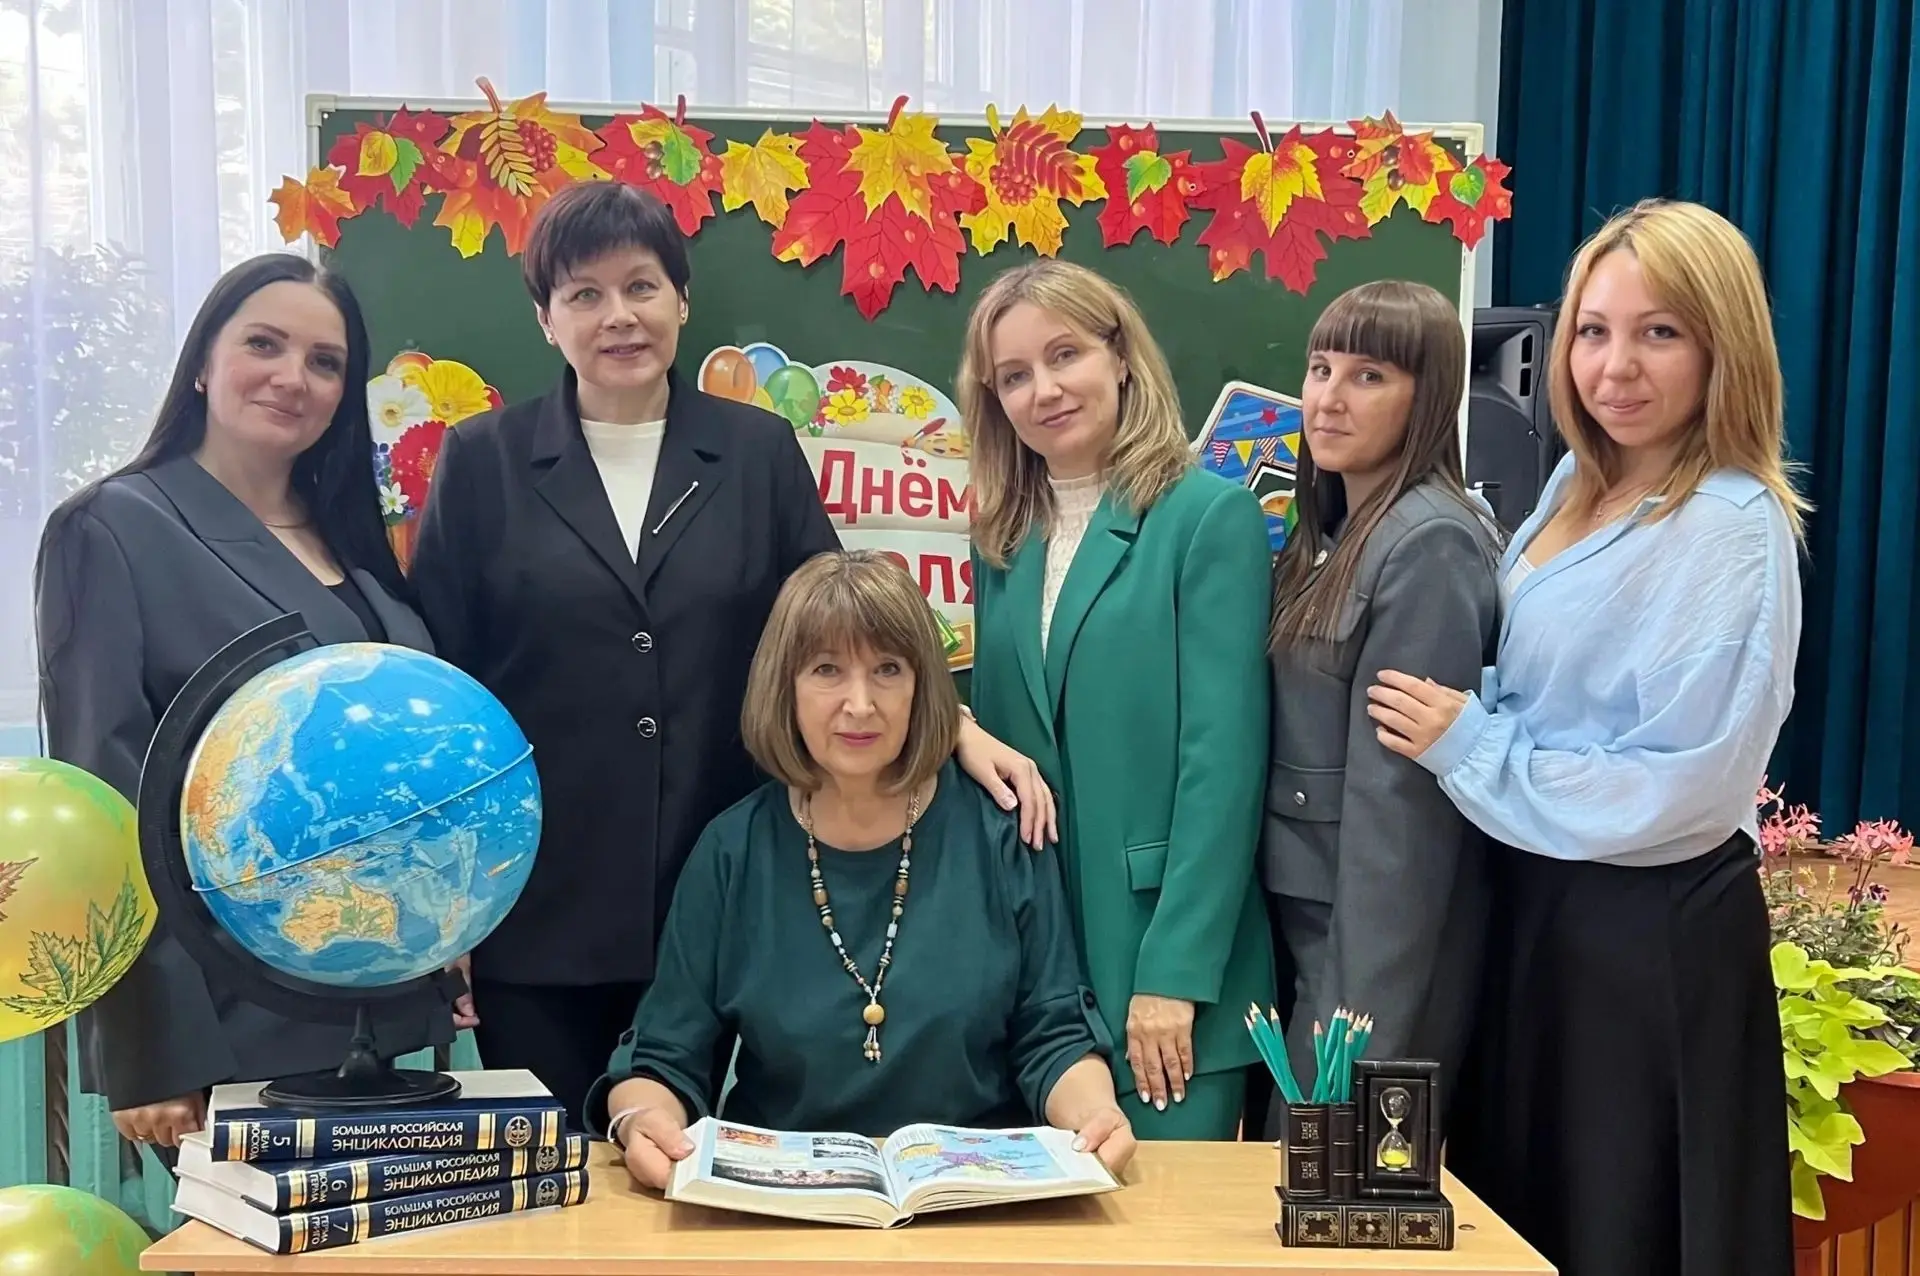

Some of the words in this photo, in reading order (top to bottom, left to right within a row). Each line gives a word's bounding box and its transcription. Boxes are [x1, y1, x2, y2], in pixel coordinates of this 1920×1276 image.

[818, 450, 979, 524] Днём
[331, 1125, 386, 1136] БОЛЬШАЯ
[390, 1121, 464, 1134] РОССИЙСКАЯ
[273, 1135, 291, 1147] 5
[331, 1134, 463, 1152] ЭНЦИКЛОПЕДИЯ
[383, 1161, 432, 1176] БОЛЬШАЯ
[435, 1152, 500, 1169] РОССИЙСКАЯ
[331, 1179, 349, 1191] 6
[383, 1164, 499, 1192] ЭНЦИКЛОПЕДИЯ
[384, 1200, 433, 1216] БОЛЬШАЯ
[436, 1190, 500, 1208] РОССИЙСКАЯ
[333, 1221, 349, 1232] 7
[384, 1202, 500, 1232] ЭНЦИКЛОПЕДИЯ
